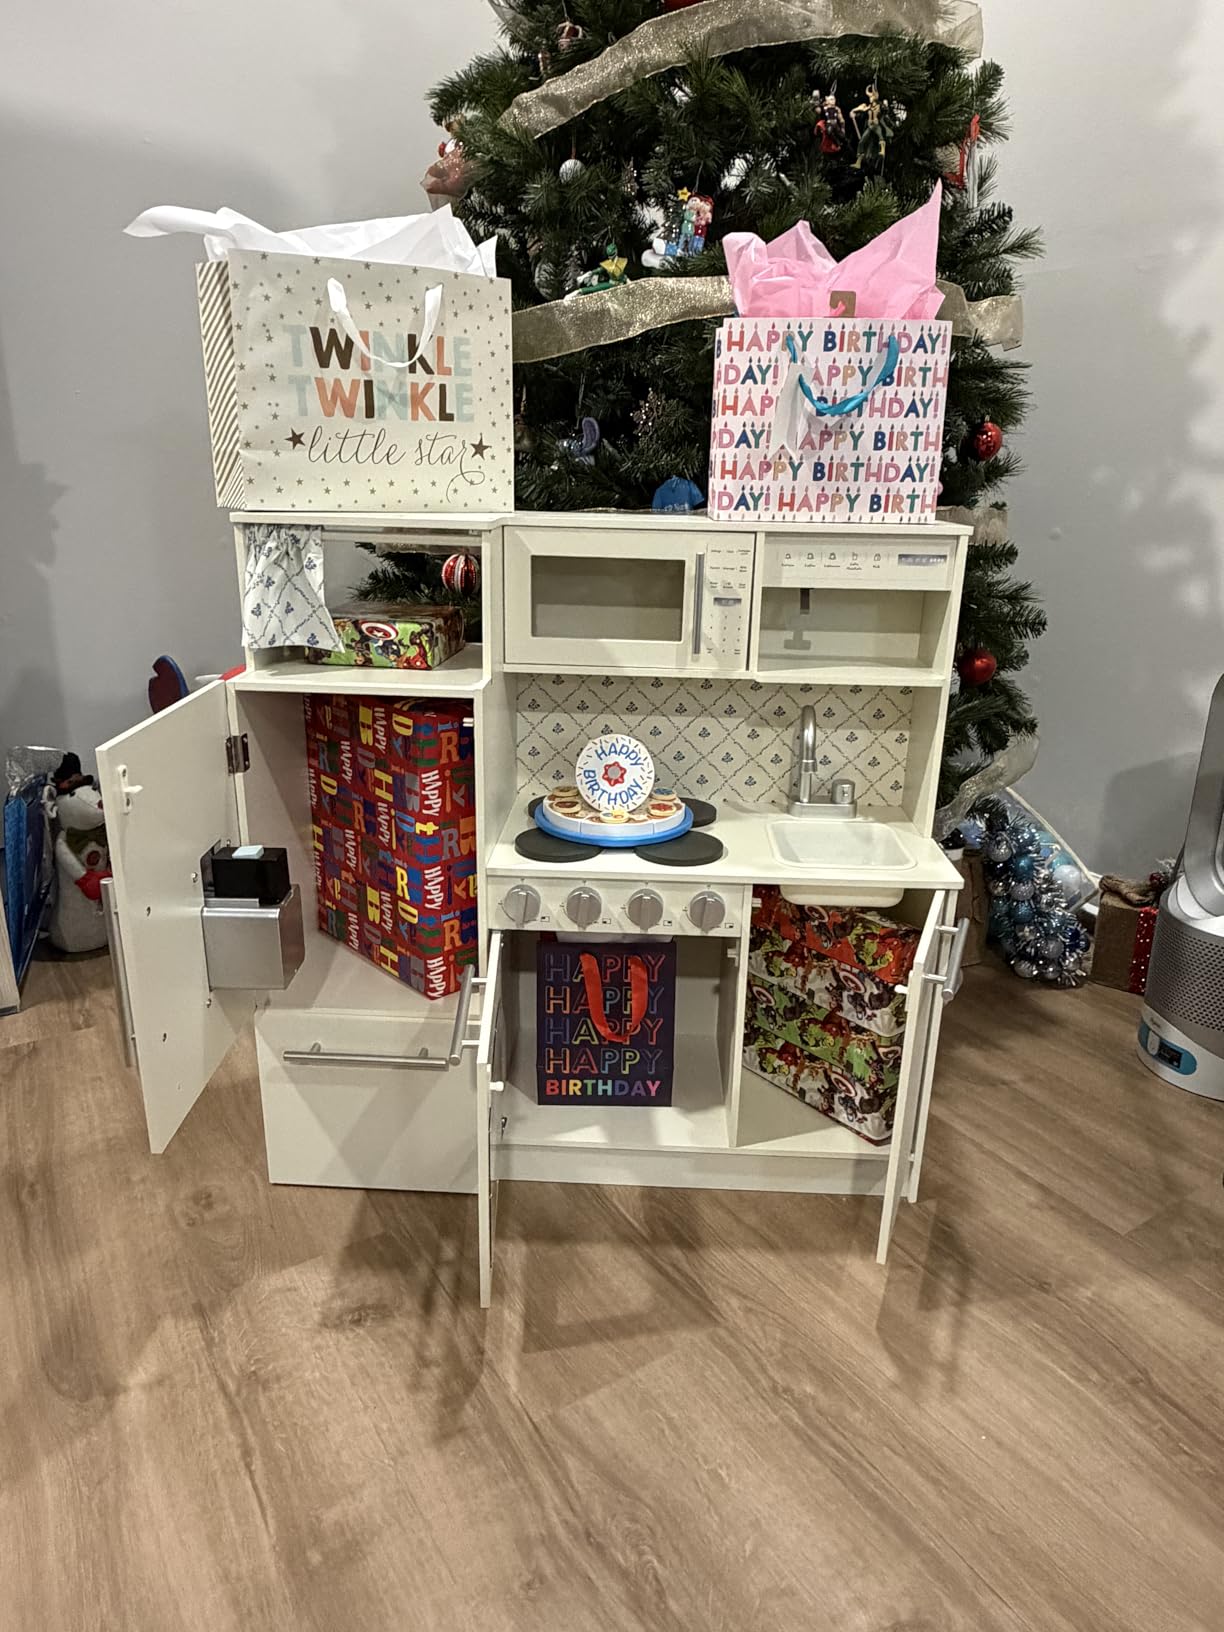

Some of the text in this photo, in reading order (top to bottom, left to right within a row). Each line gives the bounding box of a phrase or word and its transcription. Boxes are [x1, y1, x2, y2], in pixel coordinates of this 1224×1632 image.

[283, 325, 472, 376] TWINKLE
[727, 329, 813, 352] HAPPY
[723, 363, 779, 386] DAY!
[811, 364, 873, 387] APPY
[288, 375, 474, 422] TWINKLE
[721, 394, 940, 419] HAP BHDAY!
[308, 426, 406, 465] little
[718, 428, 940, 452] DAY! APPY BIRTH
[720, 460, 936, 484] HAPPY BIRTHDAY!
[718, 491, 936, 514] DAY! HAPPY BIRTH
[583, 769, 643, 805] BIRTHDAY
[545, 1047, 663, 1075] HAPPY
[546, 1079, 661, 1097] BIRTHDAY
